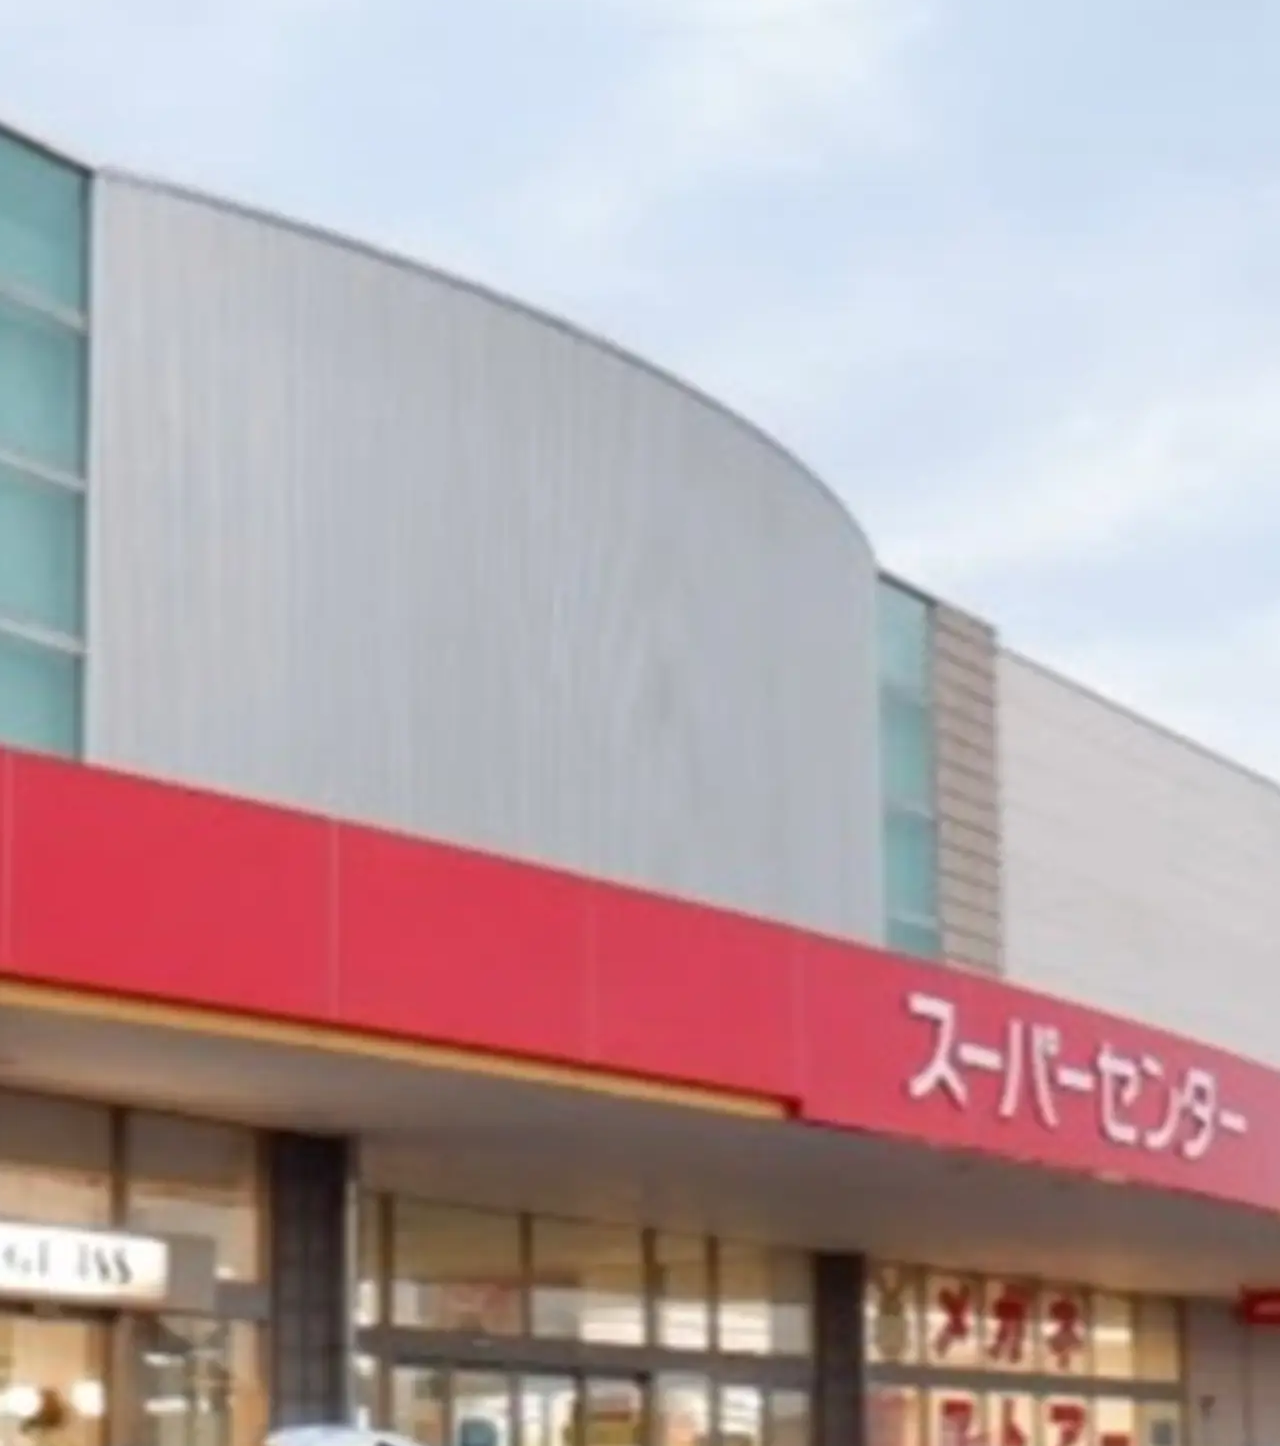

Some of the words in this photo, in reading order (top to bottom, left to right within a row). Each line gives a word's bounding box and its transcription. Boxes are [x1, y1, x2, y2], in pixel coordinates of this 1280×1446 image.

[907, 991, 1247, 1157] スーパーセンター
